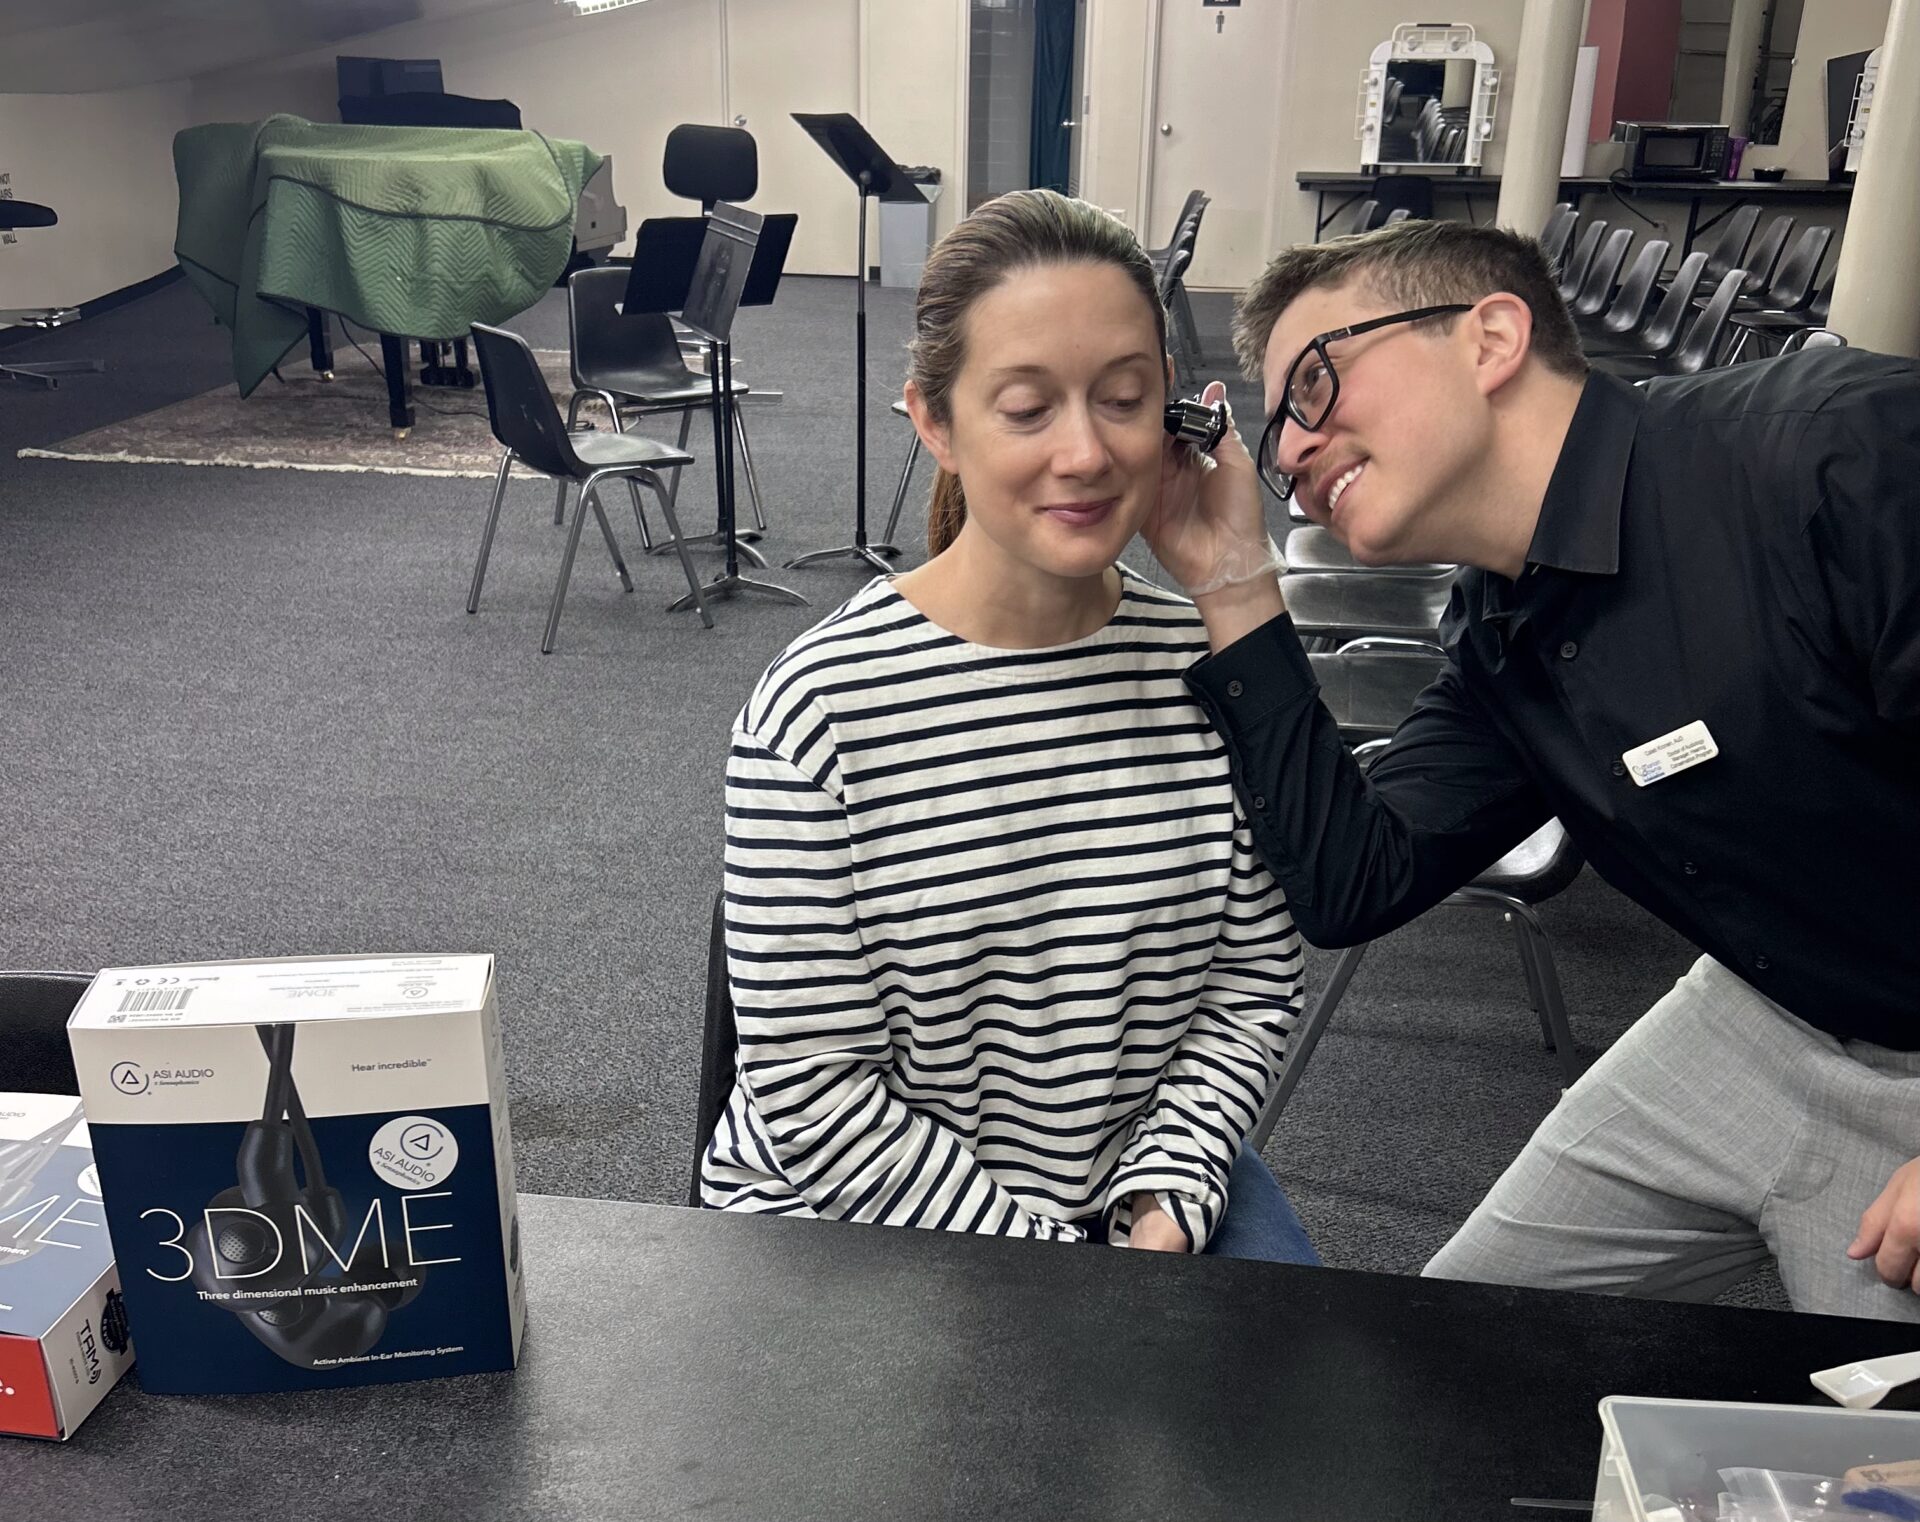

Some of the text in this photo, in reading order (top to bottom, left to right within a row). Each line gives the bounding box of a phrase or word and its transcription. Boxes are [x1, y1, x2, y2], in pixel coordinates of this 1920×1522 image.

[153, 1068, 215, 1079] ASI AUDIO
[352, 1063, 376, 1072] Hear
[373, 1147, 436, 1182] ASI AUDIO
[140, 1191, 462, 1282] 3DME
[197, 1278, 418, 1301] Three dimensional music enhancement
[313, 1346, 464, 1366] Active Ambient In-Ear Monitoring System
